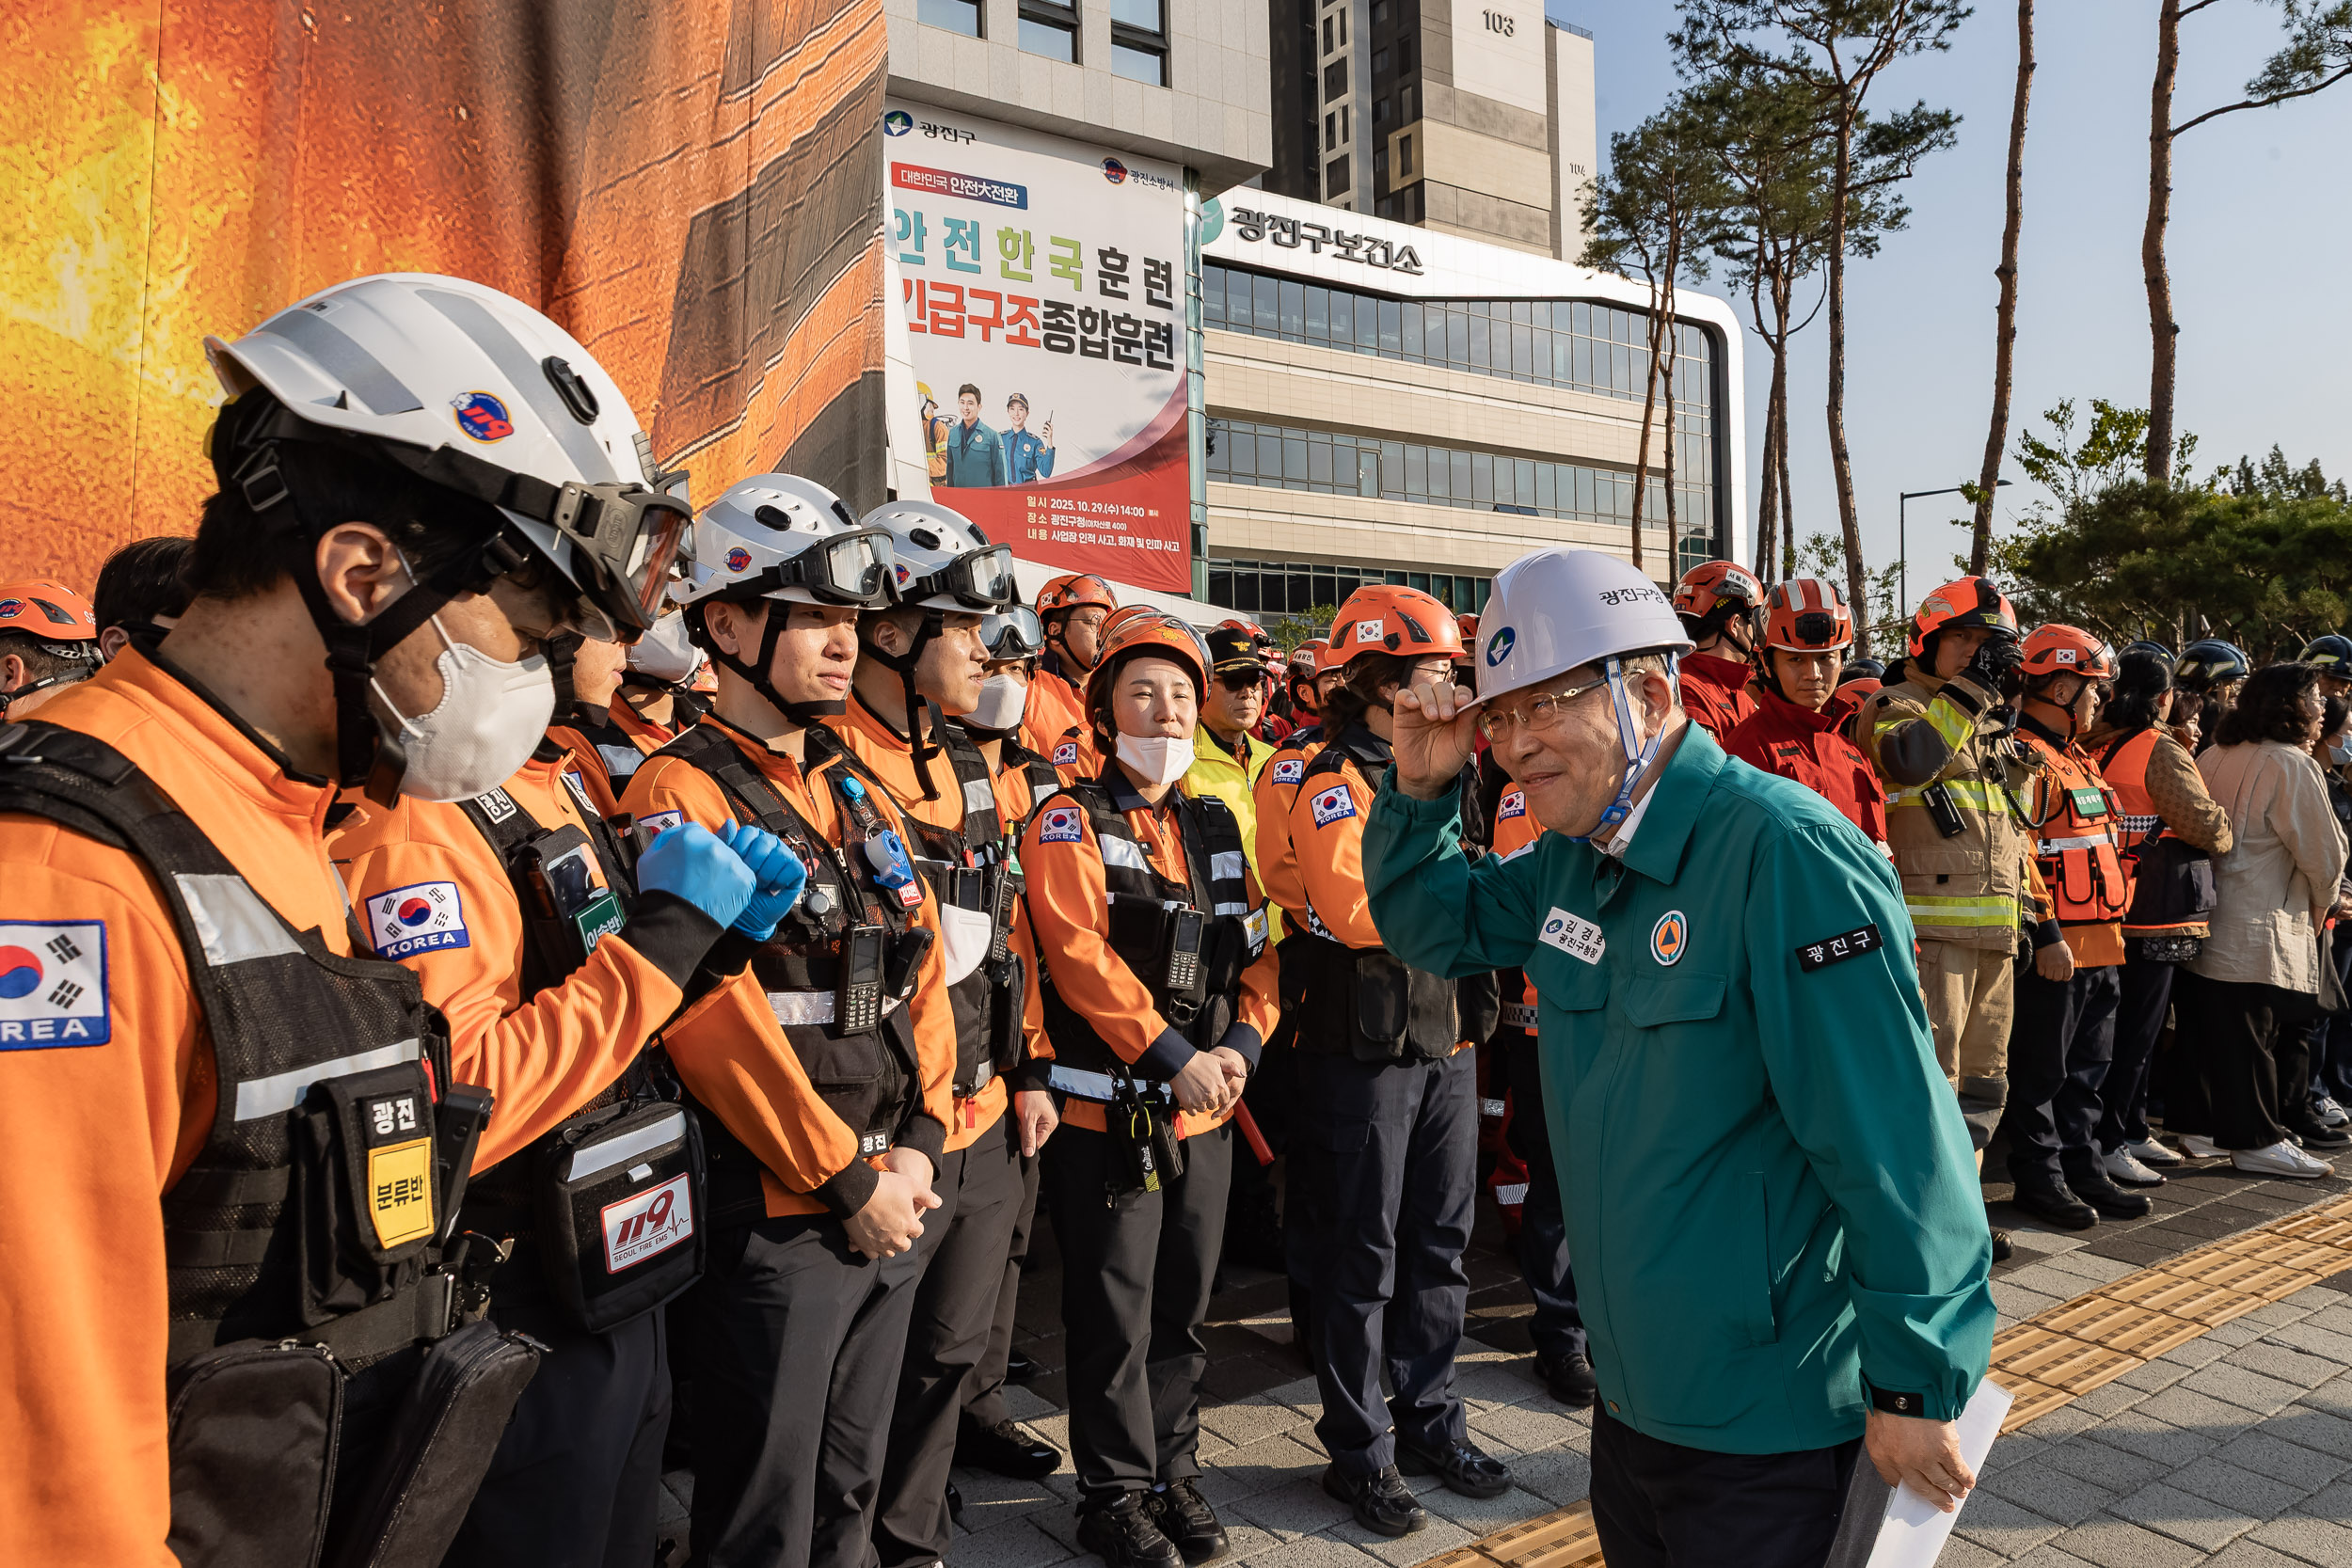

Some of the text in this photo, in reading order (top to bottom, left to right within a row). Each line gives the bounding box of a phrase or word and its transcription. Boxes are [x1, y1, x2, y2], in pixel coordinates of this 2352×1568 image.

[1483, 8, 1516, 37] 103
[919, 121, 977, 145] 광진구
[900, 169, 1019, 204] 대한민국 안전大전환
[1131, 170, 1173, 193] 광진소방서
[1232, 207, 1424, 276] 광진구보건소
[462, 405, 514, 439] 119
[1050, 499, 1075, 511] 2025.
[1077, 500, 1089, 512] 10.
[1091, 502, 1119, 515] 29.(수)
[1120, 505, 1145, 517] 14:00
[1112, 522, 1127, 531] 400)
[1051, 530, 1077, 543] 사업장
[1078, 532, 1096, 545] 인적
[1098, 534, 1117, 546] 사고,
[1118, 535, 1135, 547] 화재
[1136, 537, 1145, 549] 및
[1146, 538, 1162, 550] 인파
[1164, 540, 1180, 552] 사고
[730, 555, 752, 567] 119
[1598, 588, 1663, 605] 광진구청
[479, 788, 512, 816] 광진
[1320, 810, 1350, 825] KOREA
[387, 932, 456, 958] KOREA
[1559, 933, 1597, 958] 광진구청장
[1806, 930, 1871, 962] 광진구
[373, 1098, 416, 1134] 광진
[863, 1134, 886, 1152] 광진
[376, 1175, 423, 1211] 분류반
[614, 1190, 675, 1250] 119
[613, 1233, 668, 1263] SEOUL FIRE EMS
